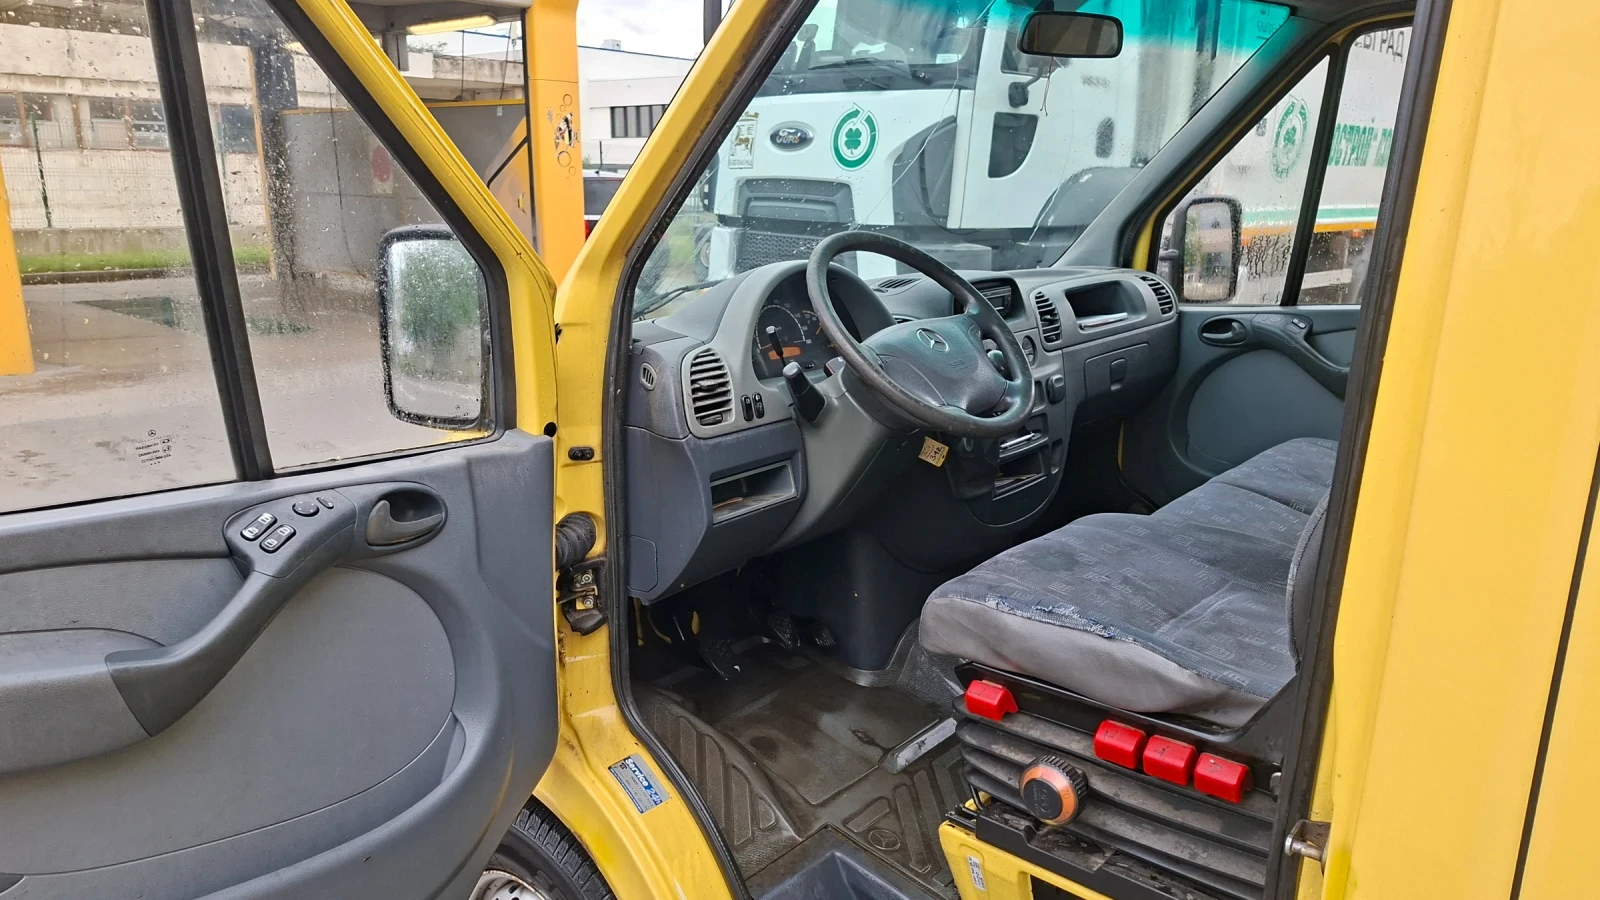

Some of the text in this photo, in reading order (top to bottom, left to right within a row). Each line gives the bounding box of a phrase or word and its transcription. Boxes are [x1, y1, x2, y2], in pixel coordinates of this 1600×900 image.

[775, 128, 801, 144] Ford
[625, 758, 649, 787] Service
[646, 787, 662, 804] 24h
